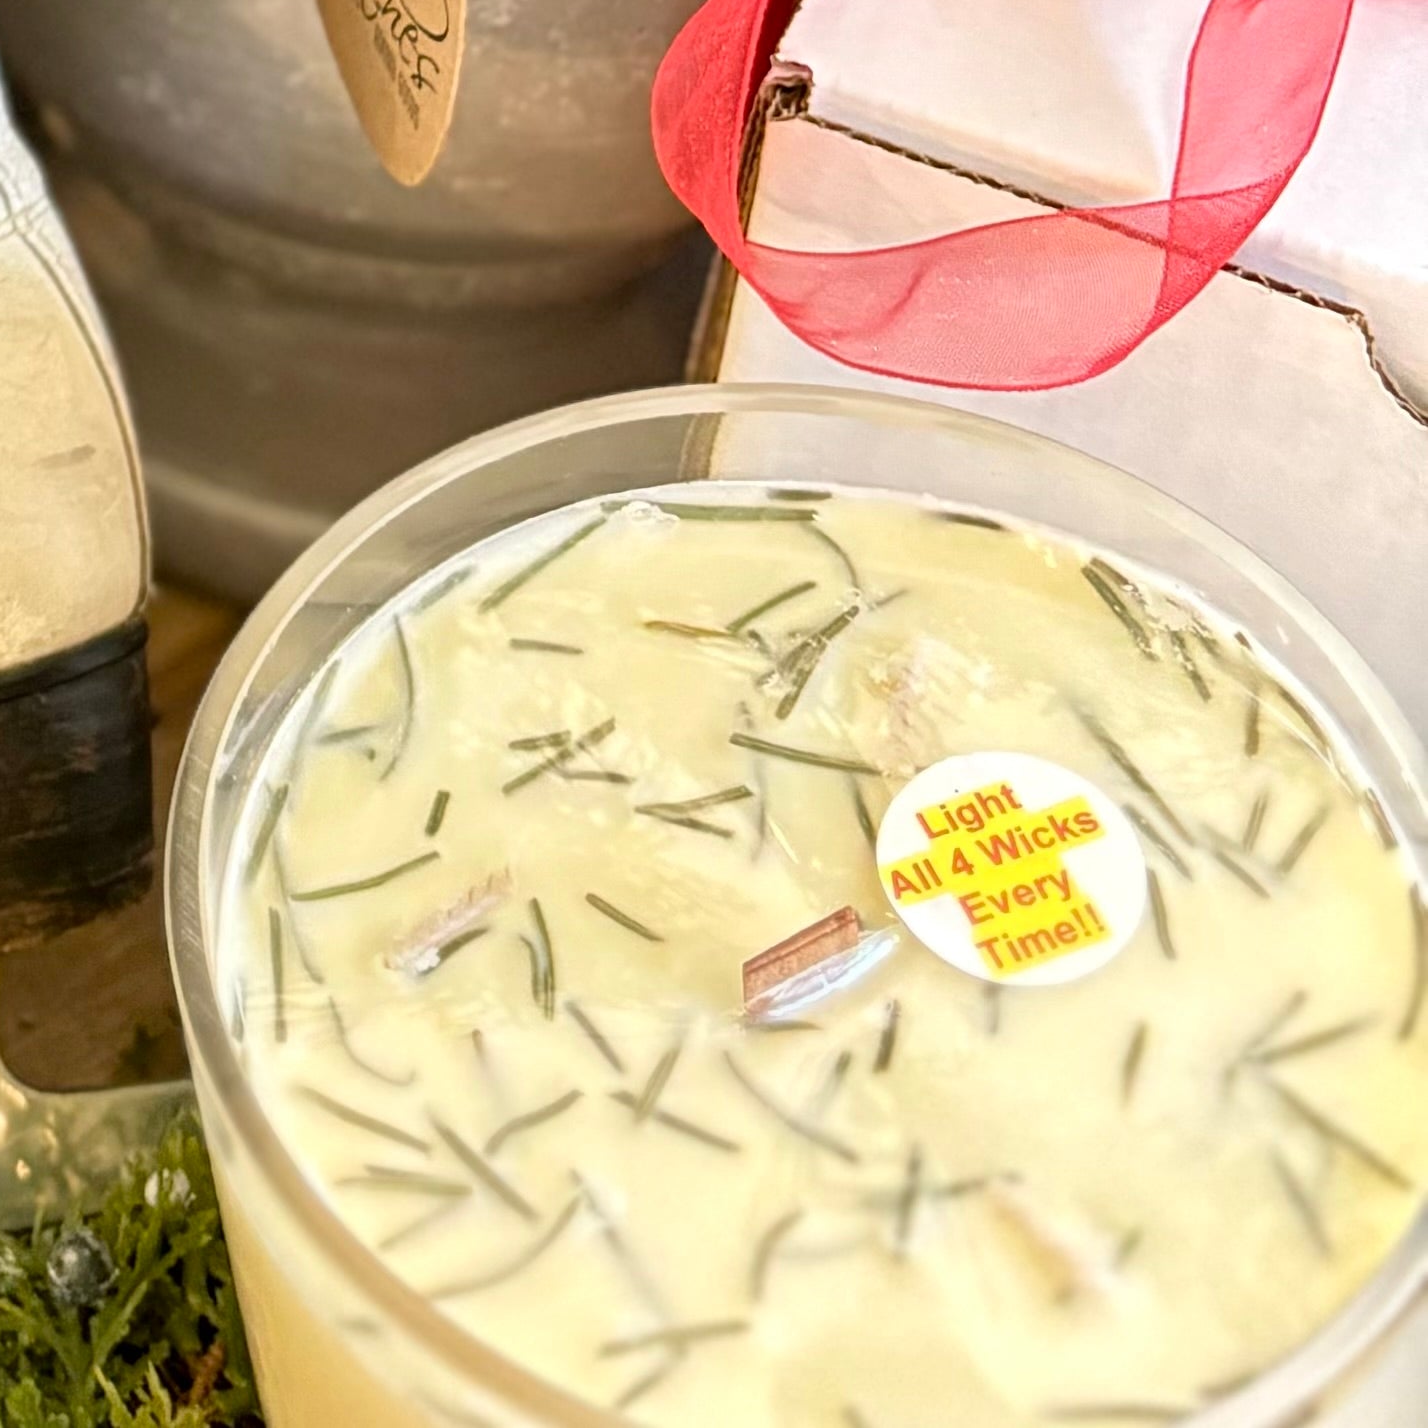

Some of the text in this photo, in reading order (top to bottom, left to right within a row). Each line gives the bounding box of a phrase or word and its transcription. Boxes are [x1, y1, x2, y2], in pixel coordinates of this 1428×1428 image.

[915, 783, 1023, 840] Light
[889, 809, 1101, 900] All 4 Wicks
[958, 868, 1073, 926] Every
[975, 902, 1106, 970] Time!!
